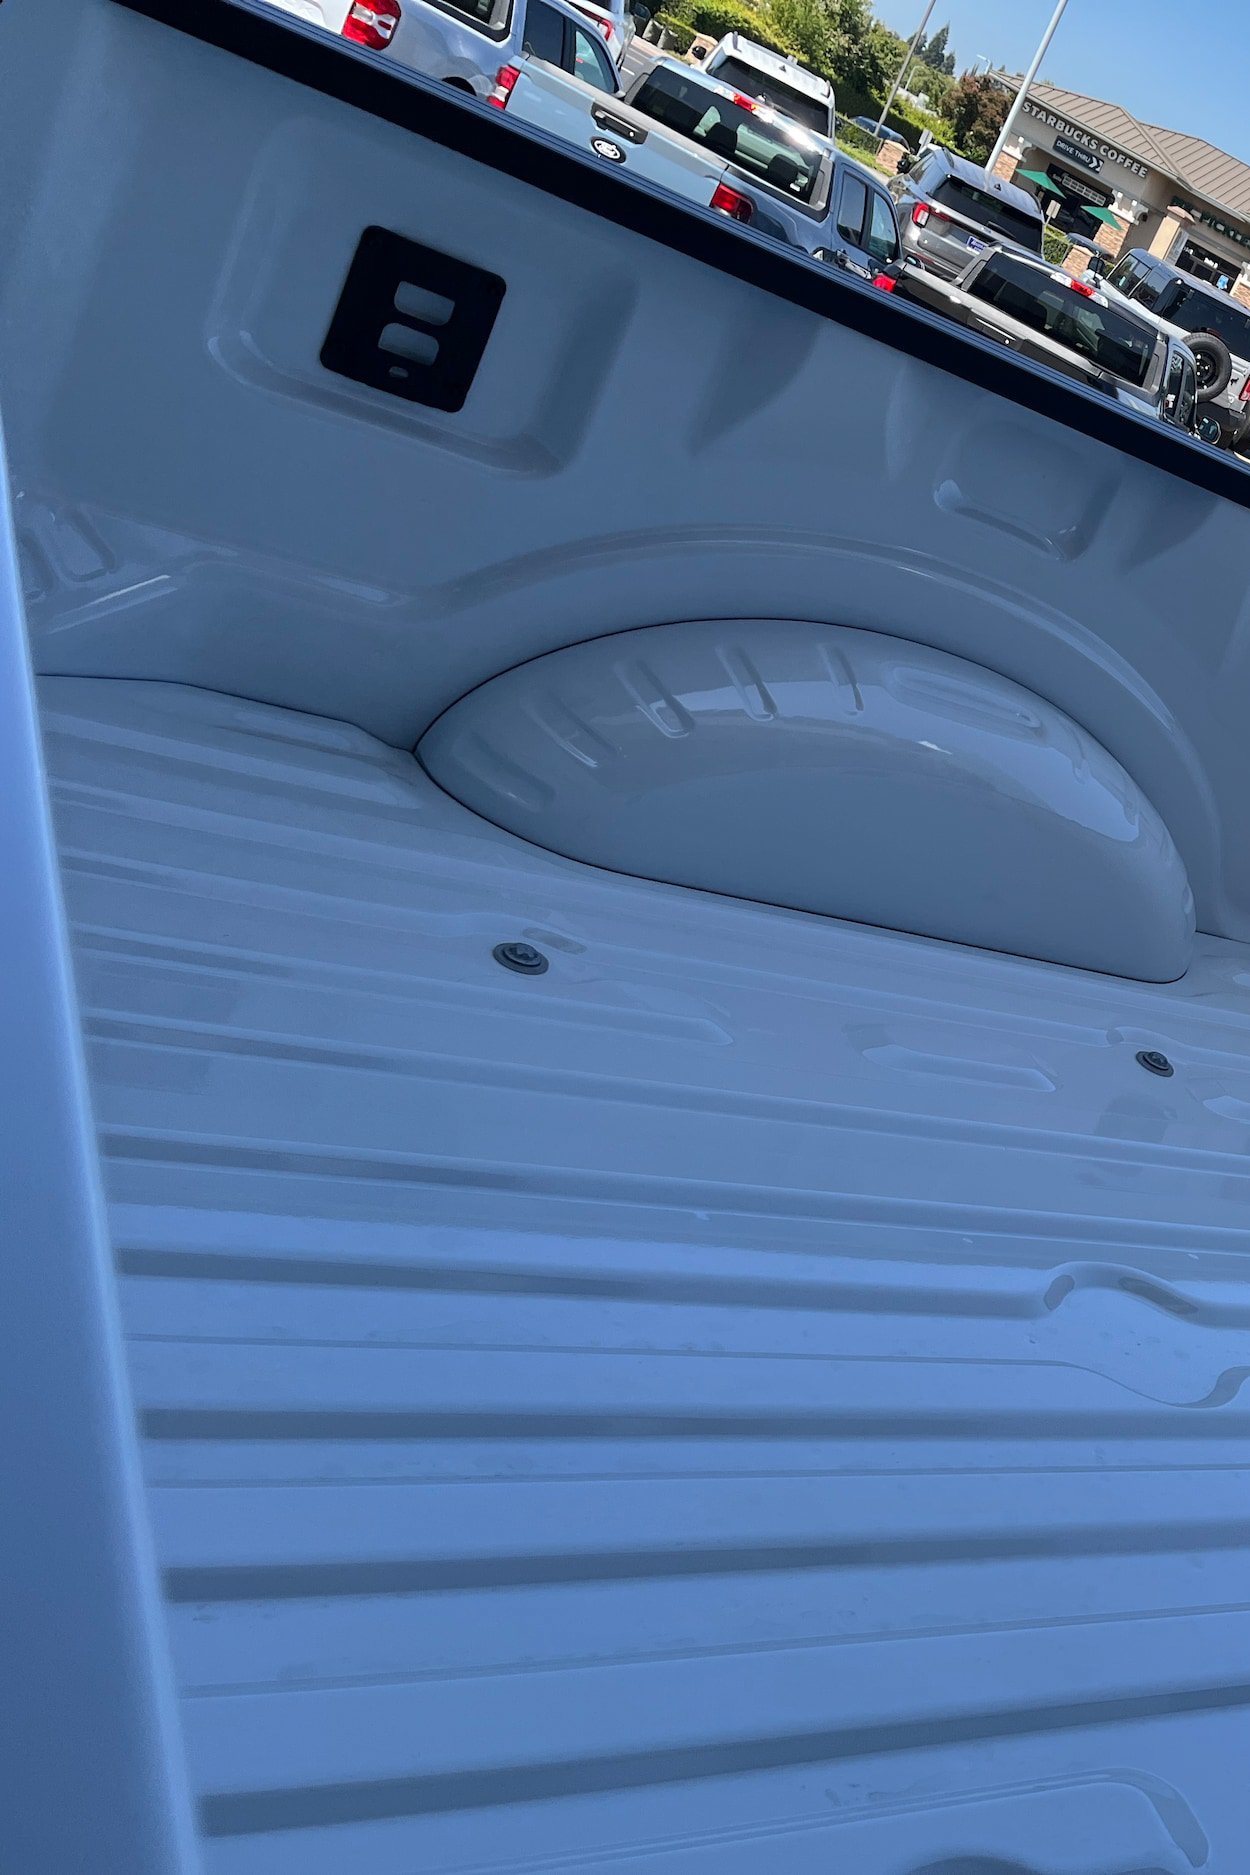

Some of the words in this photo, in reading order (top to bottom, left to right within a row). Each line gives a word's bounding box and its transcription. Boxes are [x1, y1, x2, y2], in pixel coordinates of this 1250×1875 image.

[1022, 101, 1099, 150] STARBUCKS
[1099, 145, 1148, 179] COFFEE
[1056, 140, 1075, 156] DRIVE
[1074, 149, 1091, 163] THRU
